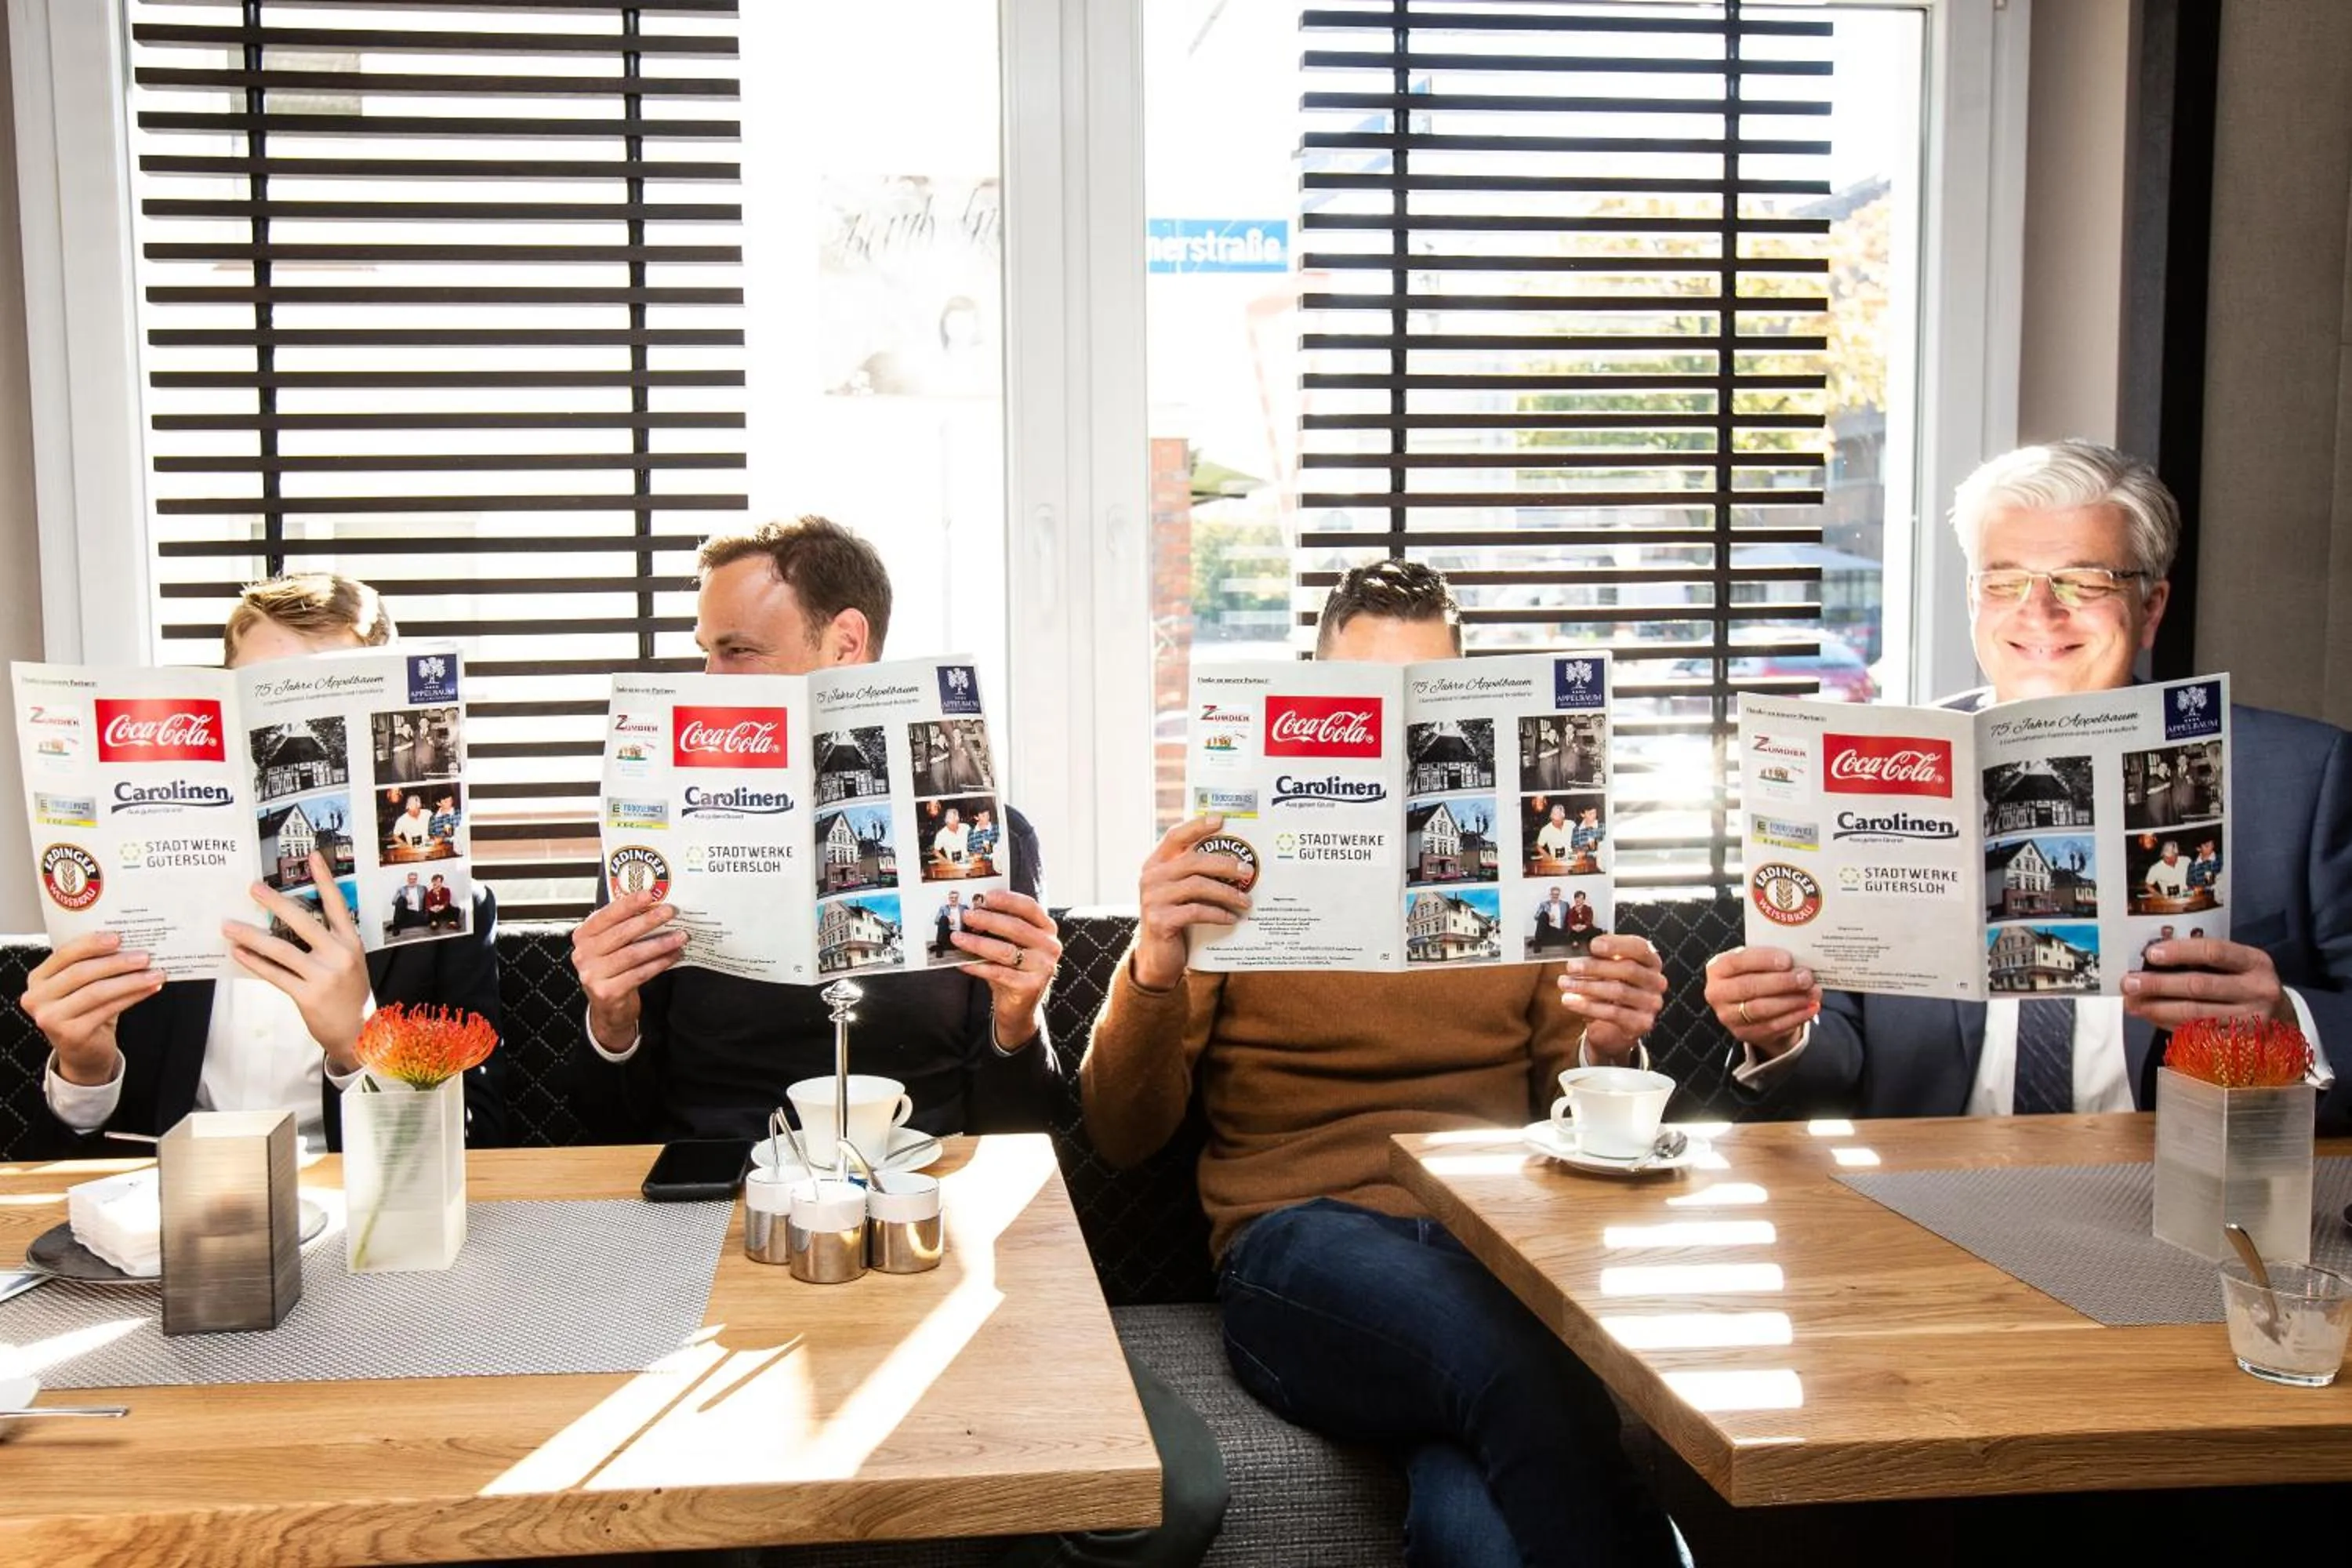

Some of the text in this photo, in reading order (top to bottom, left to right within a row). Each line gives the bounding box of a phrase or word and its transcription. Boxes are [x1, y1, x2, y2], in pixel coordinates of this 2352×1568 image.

[255, 683, 271, 697] 75
[274, 679, 313, 695] Jahre
[314, 675, 384, 690] Appelbaum
[1429, 678, 1465, 694] Jahre
[1466, 677, 1531, 691] Appelbaum
[1991, 721, 2012, 738] 75
[2013, 717, 2056, 735] Jahre
[2058, 713, 2139, 728] Appelbaum
[114, 779, 230, 802] Carolinen
[1276, 775, 1381, 796] Carolinen
[684, 786, 789, 807] Carolinen
[1838, 811, 1953, 833] Carolinen
[145, 839, 237, 853] STADTWERKE
[1299, 833, 1385, 846] STADTWERKE
[45, 847, 96, 875] ERDINGER
[708, 846, 793, 858] STADTWERKE
[612, 849, 666, 877] ERDINGER
[1755, 866, 1815, 895] ERDINGER
[1865, 867, 1958, 882] STADTWERKE
